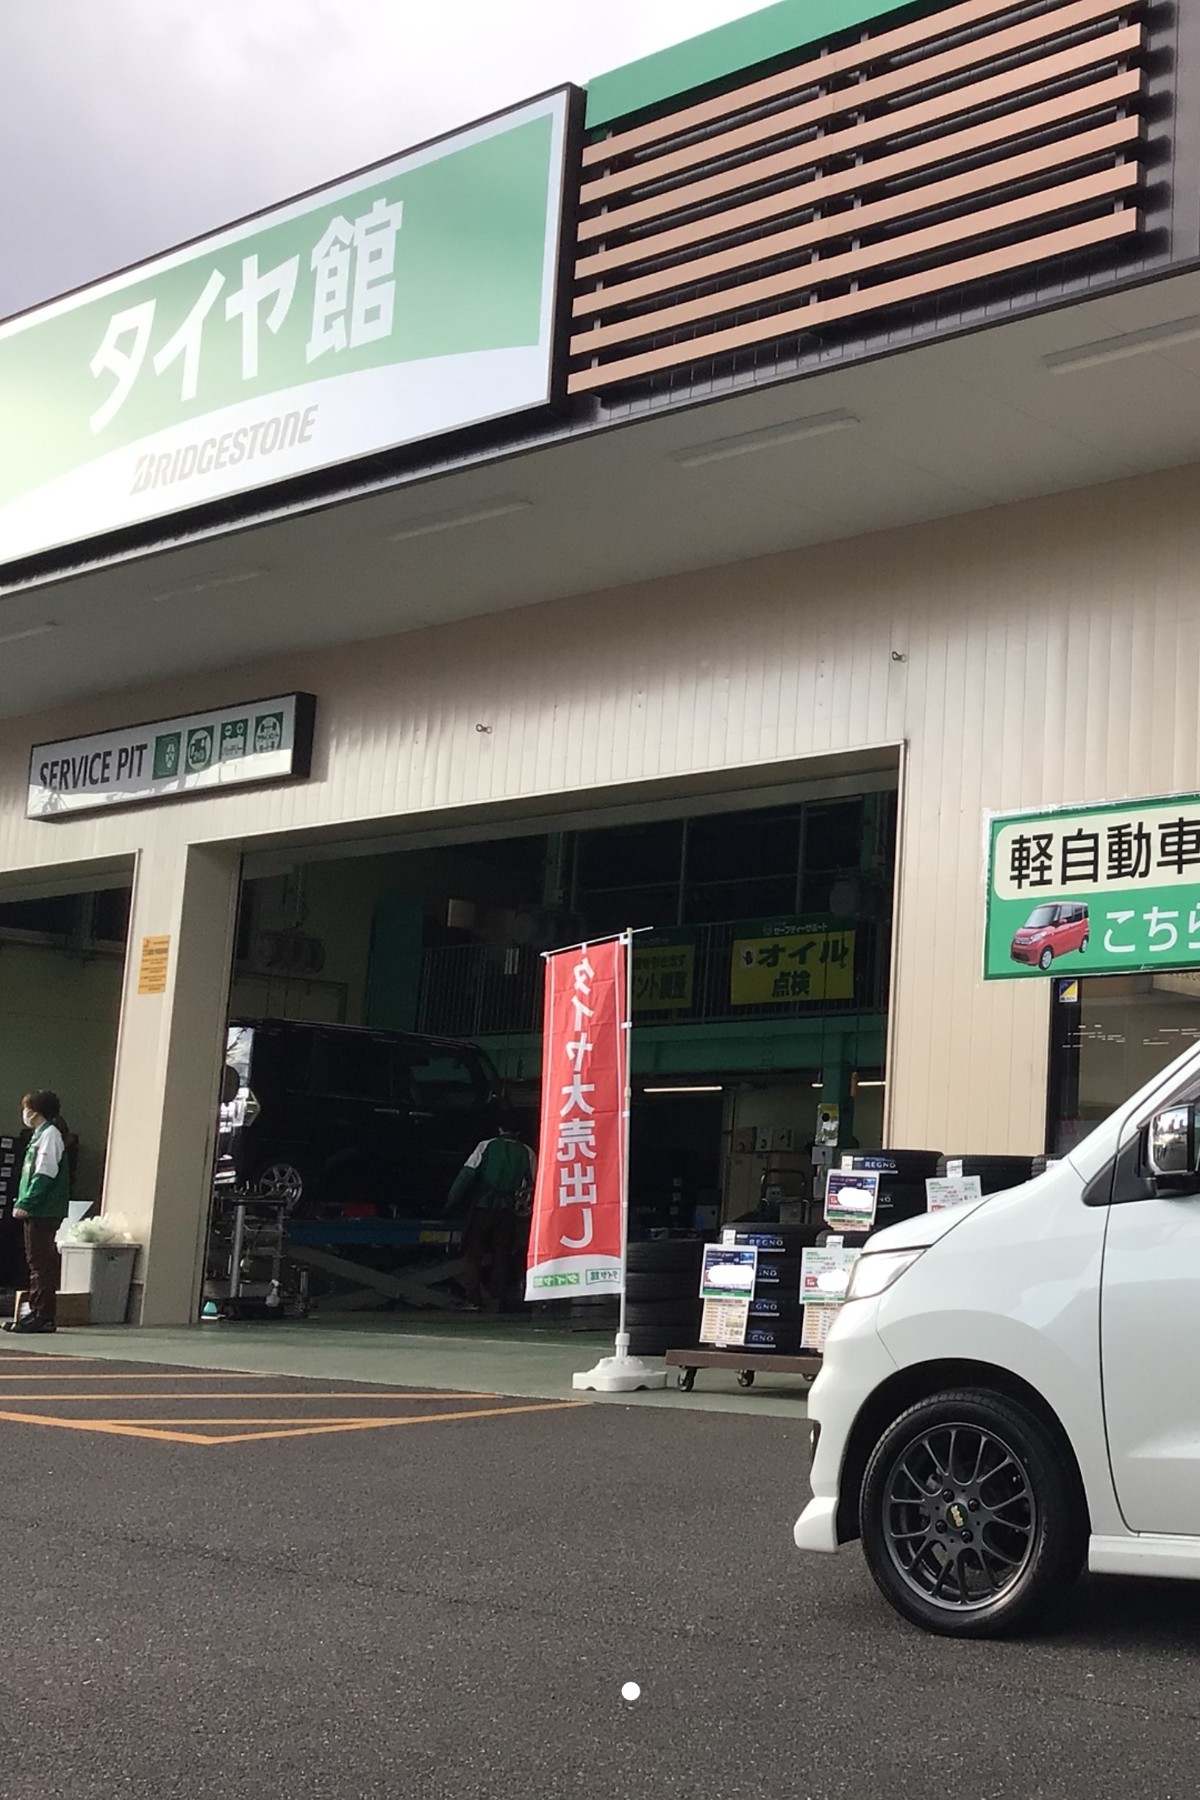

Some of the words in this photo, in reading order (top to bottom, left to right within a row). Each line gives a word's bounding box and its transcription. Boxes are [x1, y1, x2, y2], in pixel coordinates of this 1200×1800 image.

[89, 197, 403, 437] タイヤ館
[130, 404, 318, 495] BRIDGESTONE
[39, 750, 112, 791] SERVICE
[116, 743, 148, 782] PIT
[757, 939, 849, 967] オイル
[772, 970, 811, 997] 点検
[865, 1161, 897, 1169] REGNO
[749, 1238, 784, 1247] REGNO
